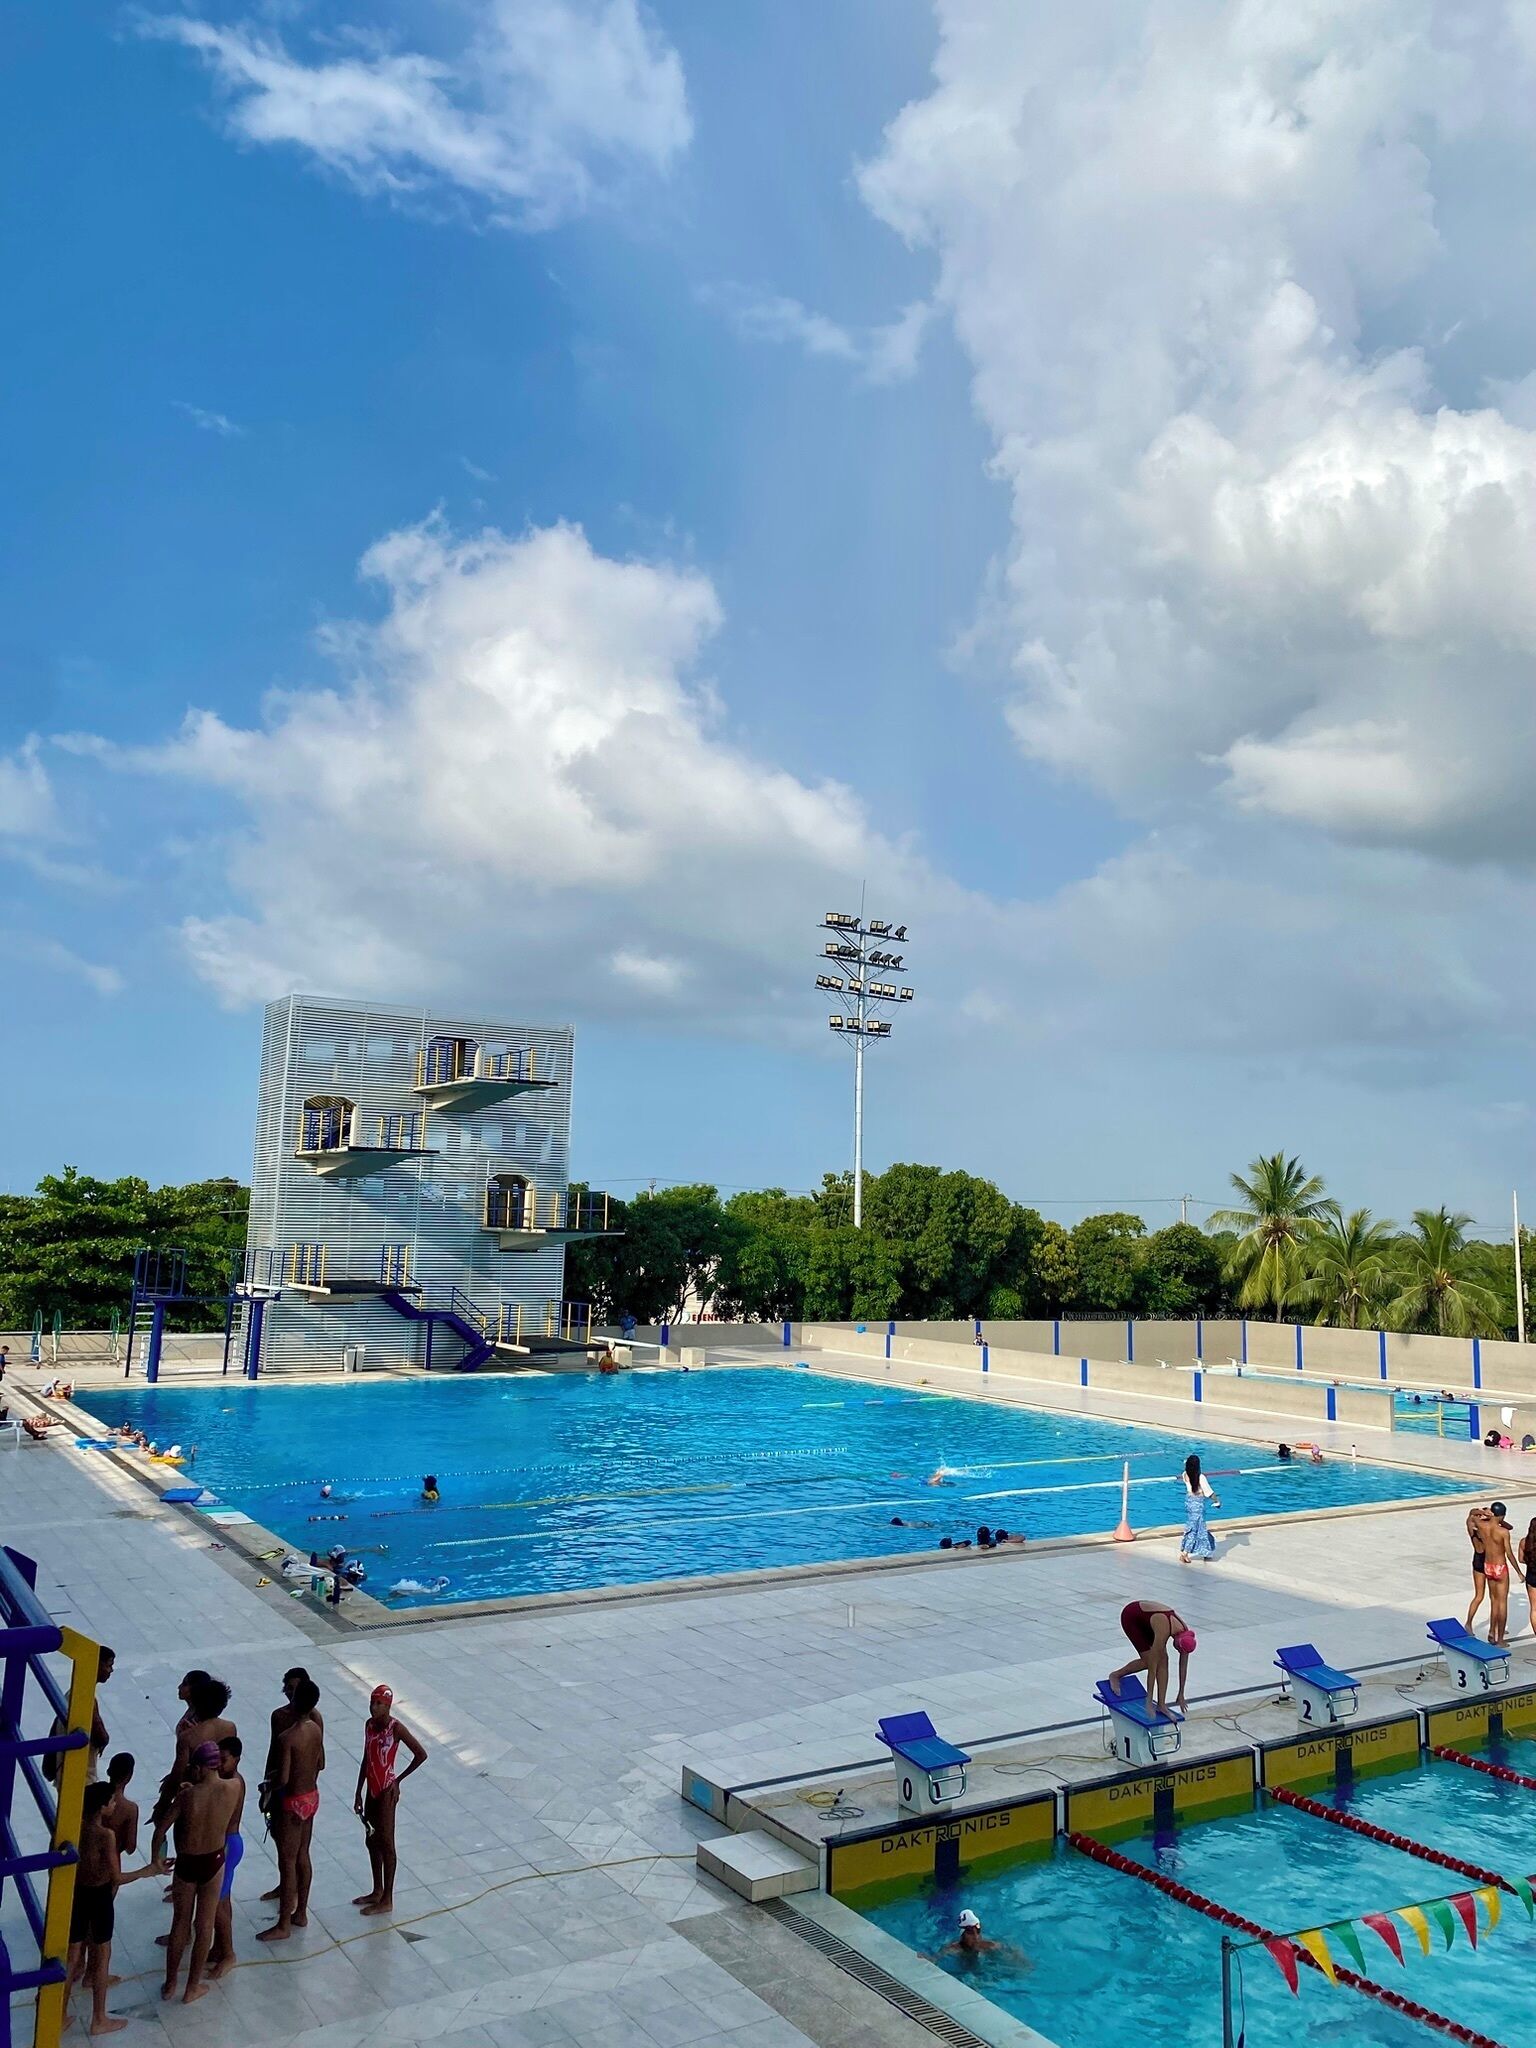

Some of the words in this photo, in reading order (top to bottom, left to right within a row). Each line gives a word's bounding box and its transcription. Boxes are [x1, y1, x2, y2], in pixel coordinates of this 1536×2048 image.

[1457, 1669, 1467, 1688] 3
[1302, 1699, 1312, 1721] 2
[1456, 1695, 1533, 1722] DAKTRONICS
[1123, 1736, 1131, 1759] 1
[1297, 1728, 1388, 1759] DAKTRONICS
[902, 1777, 913, 1802] 0
[1109, 1766, 1217, 1801] DAKTRONICS
[881, 1812, 1011, 1854] DAKTRONICS
